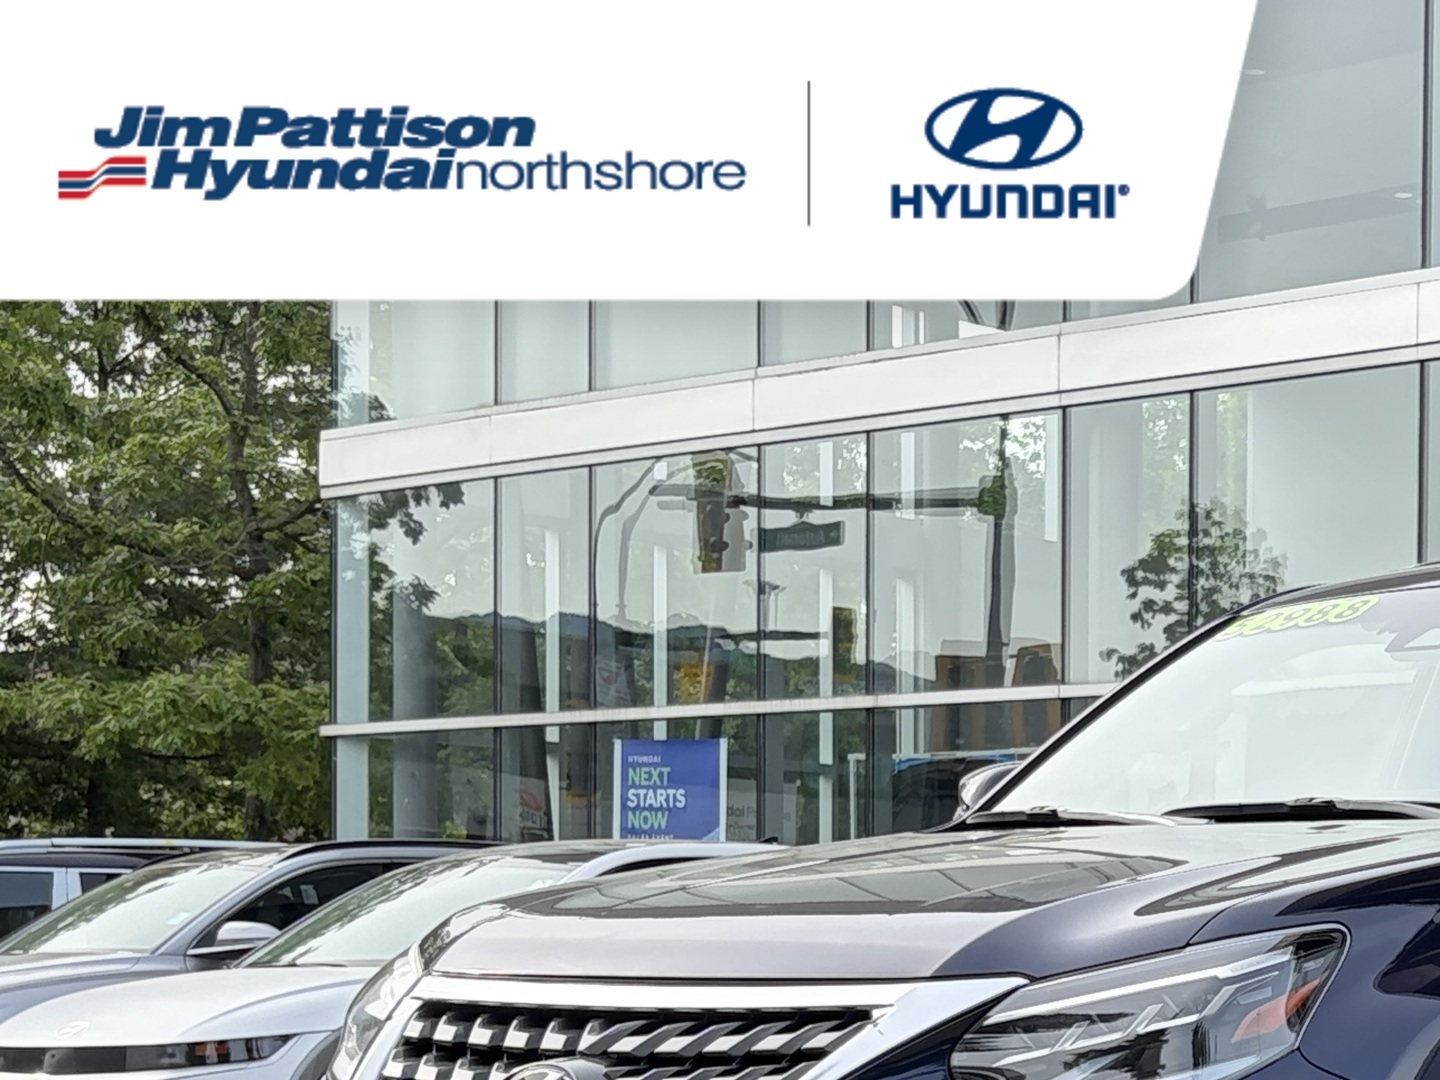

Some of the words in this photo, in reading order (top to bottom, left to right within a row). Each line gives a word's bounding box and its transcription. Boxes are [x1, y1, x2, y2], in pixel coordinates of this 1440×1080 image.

[628, 767, 671, 786] NEXT
[626, 788, 686, 808] STARTS
[628, 811, 669, 829] NOW
